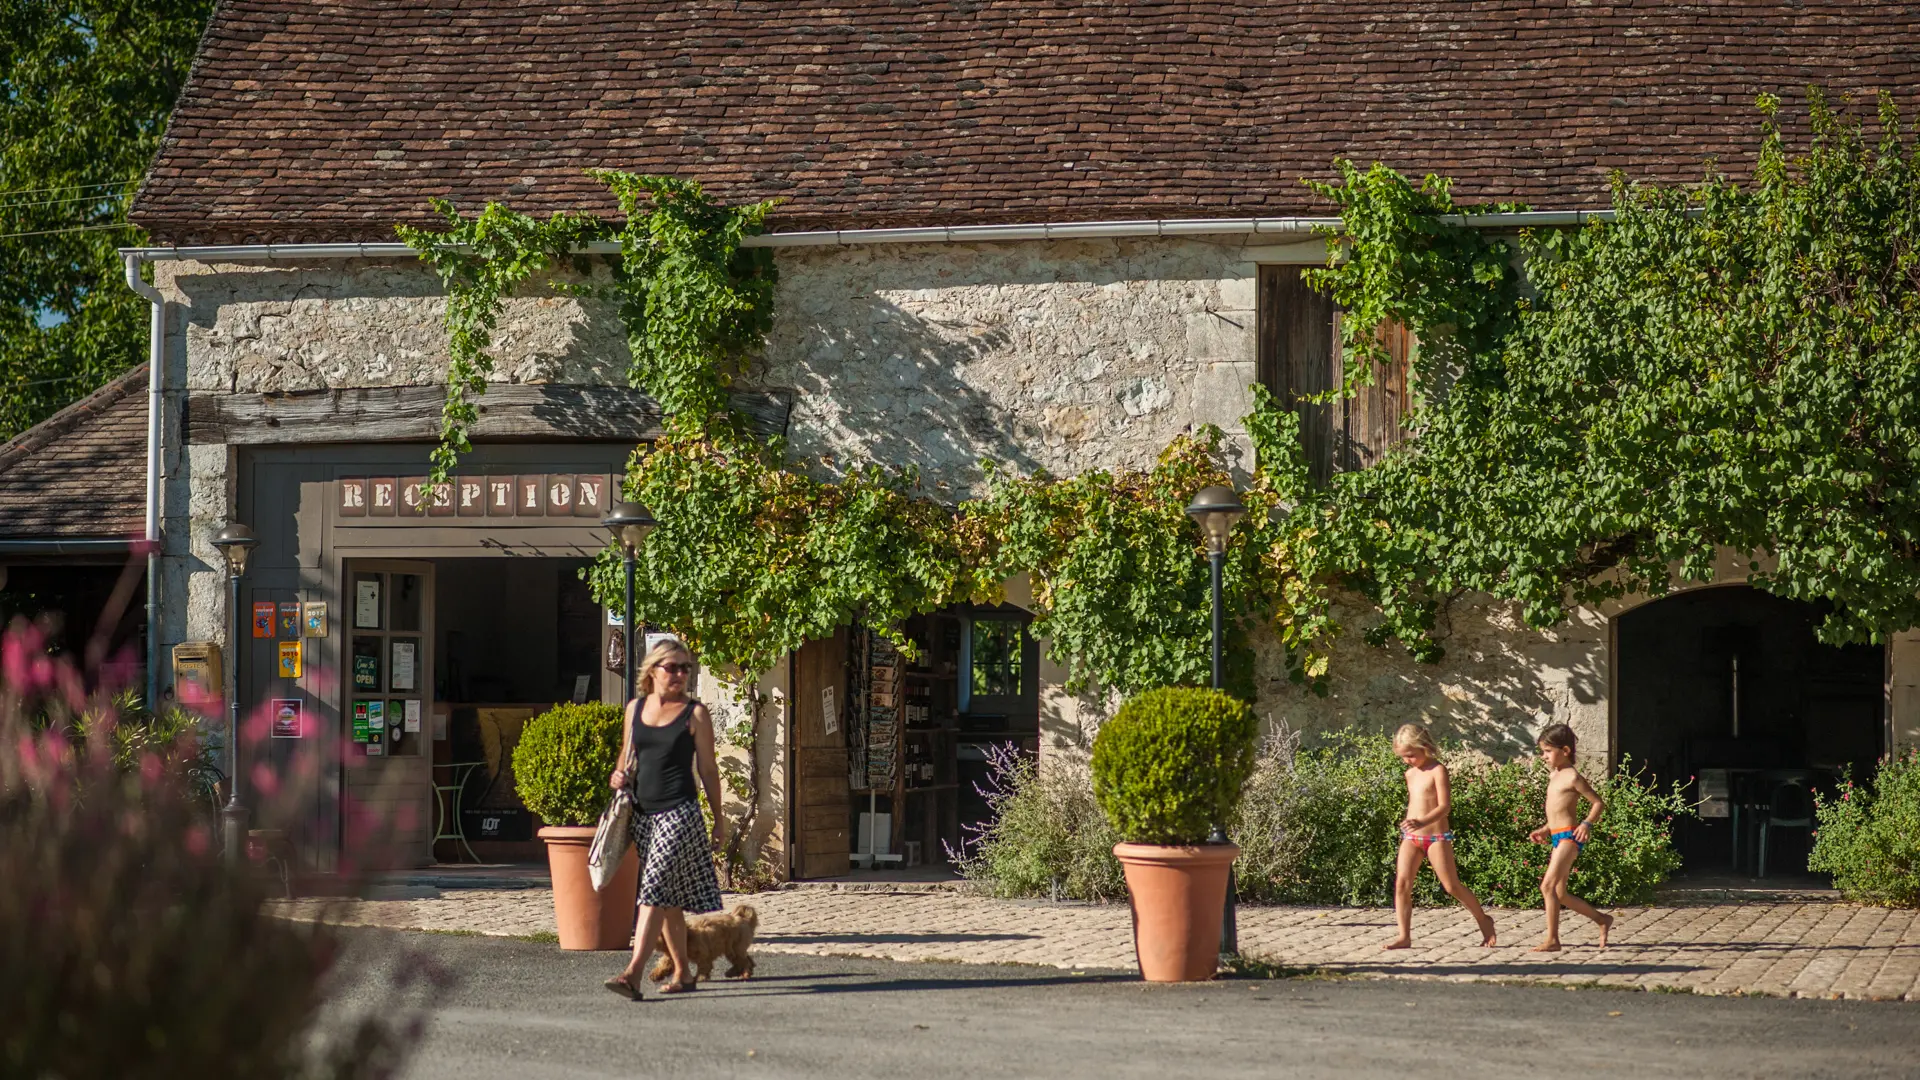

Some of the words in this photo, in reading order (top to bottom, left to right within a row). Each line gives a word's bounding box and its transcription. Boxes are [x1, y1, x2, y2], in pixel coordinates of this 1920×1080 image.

[343, 482, 600, 507] RECEPTION
[356, 674, 374, 684] OPEN
[482, 818, 500, 831] LOT
